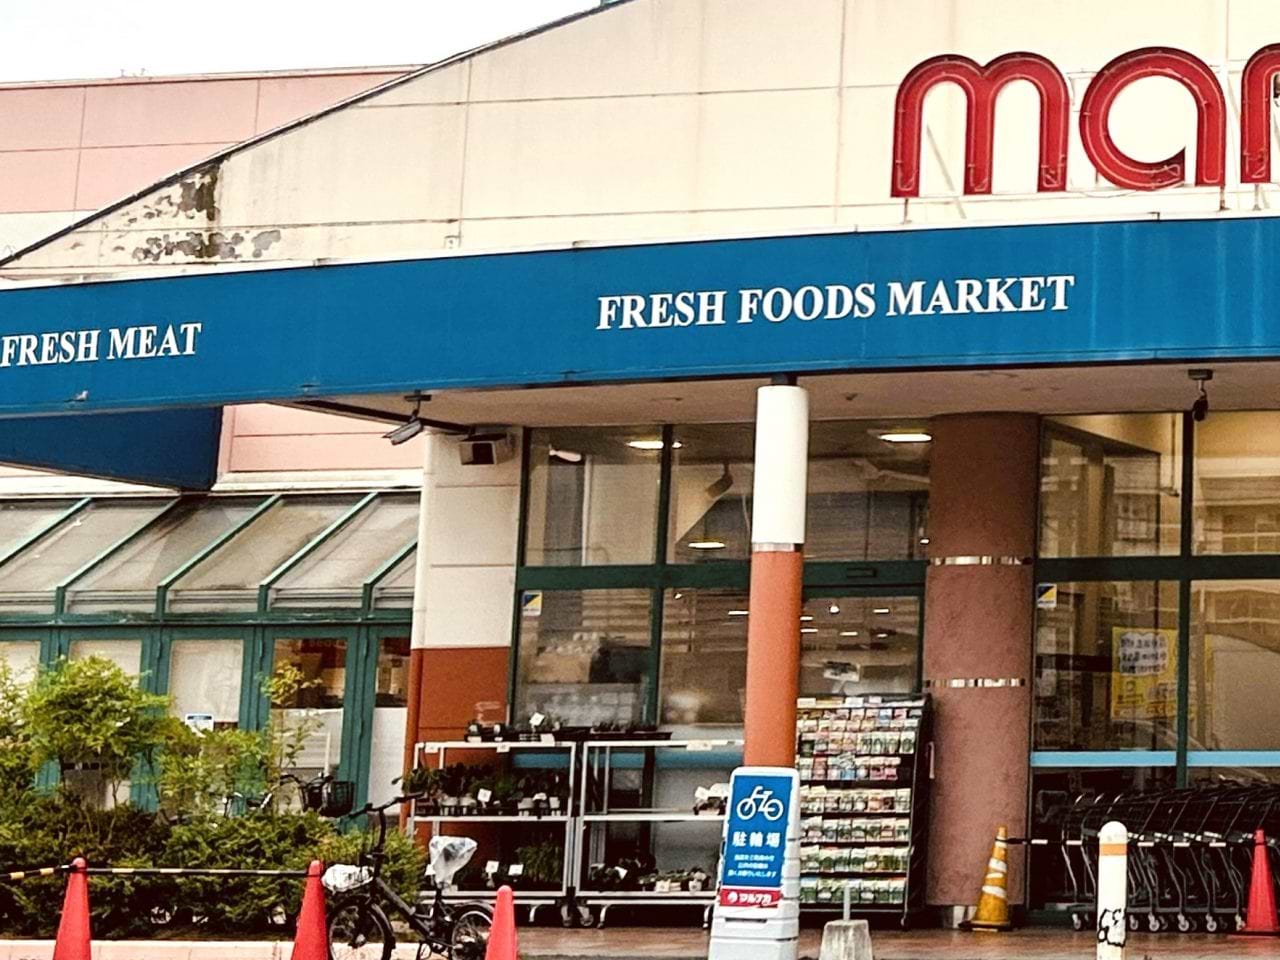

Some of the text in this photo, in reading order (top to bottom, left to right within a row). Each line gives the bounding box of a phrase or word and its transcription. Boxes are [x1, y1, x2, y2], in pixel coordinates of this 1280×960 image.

[596, 275, 1075, 330] FRESH FOODS MARKET
[0, 322, 202, 367] FRESH MEAT
[732, 831, 781, 848] 駐輪場
[739, 893, 773, 906] マルナカ
